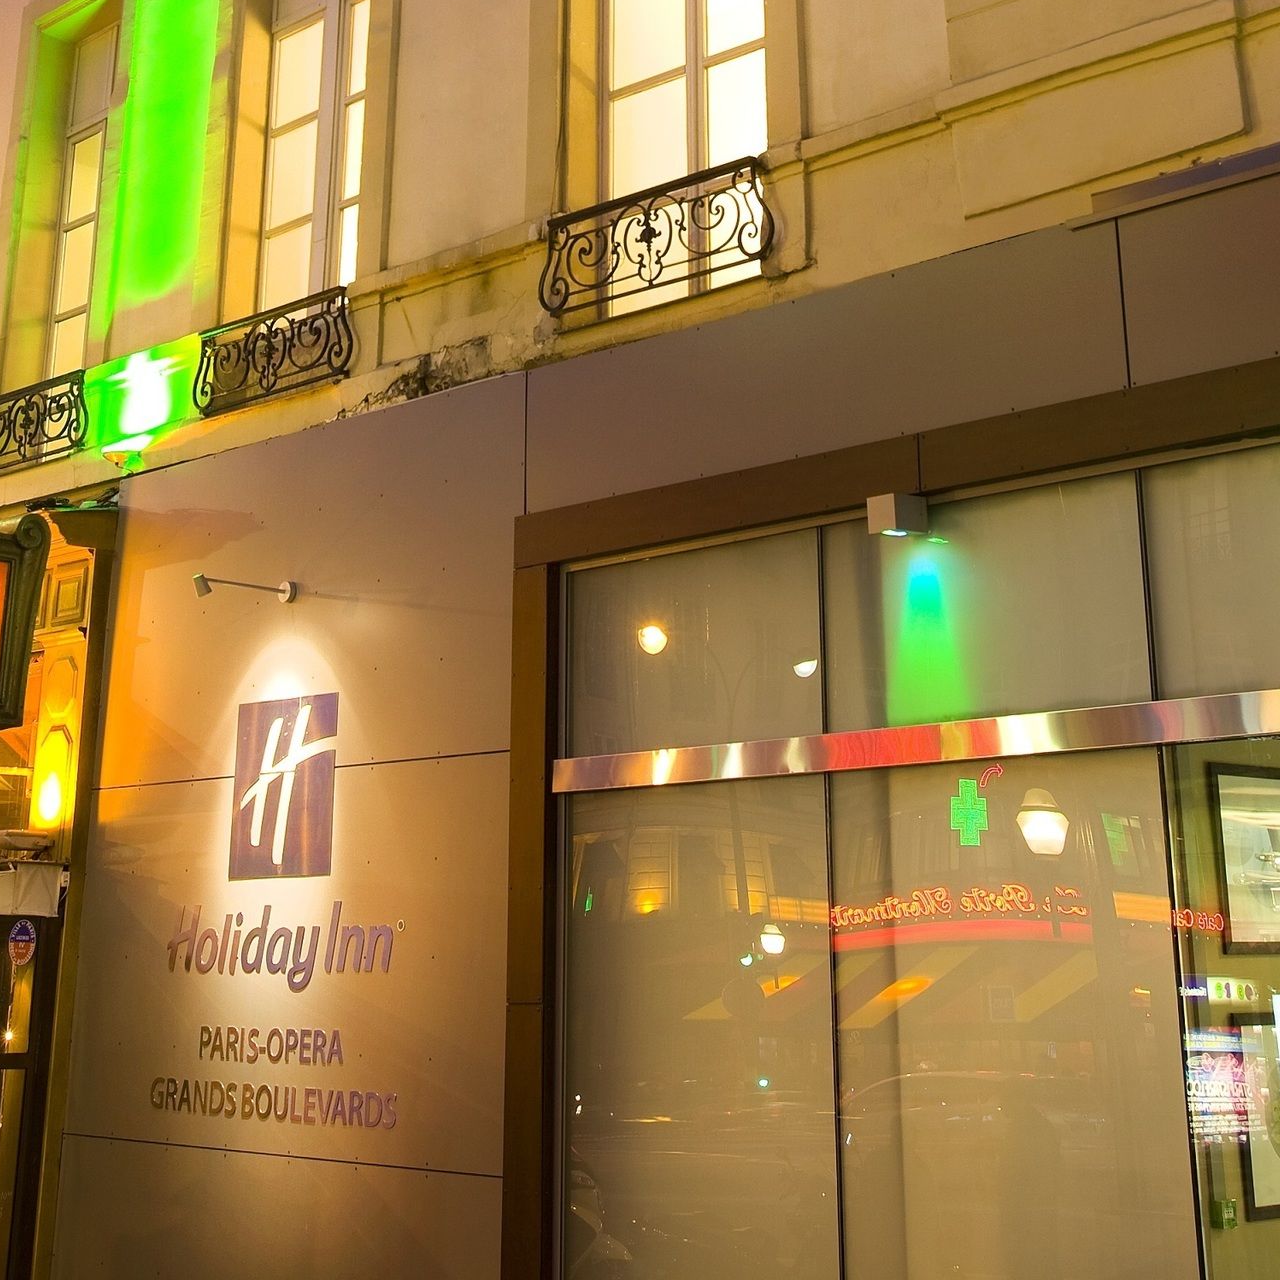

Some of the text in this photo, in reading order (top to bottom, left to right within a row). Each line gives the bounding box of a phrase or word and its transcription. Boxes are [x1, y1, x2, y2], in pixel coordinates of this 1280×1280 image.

[167, 900, 394, 993] Holiday Inn
[198, 1025, 344, 1066] PARIS-OPERA
[150, 1077, 398, 1130] GRANDS BOULEVARDS
